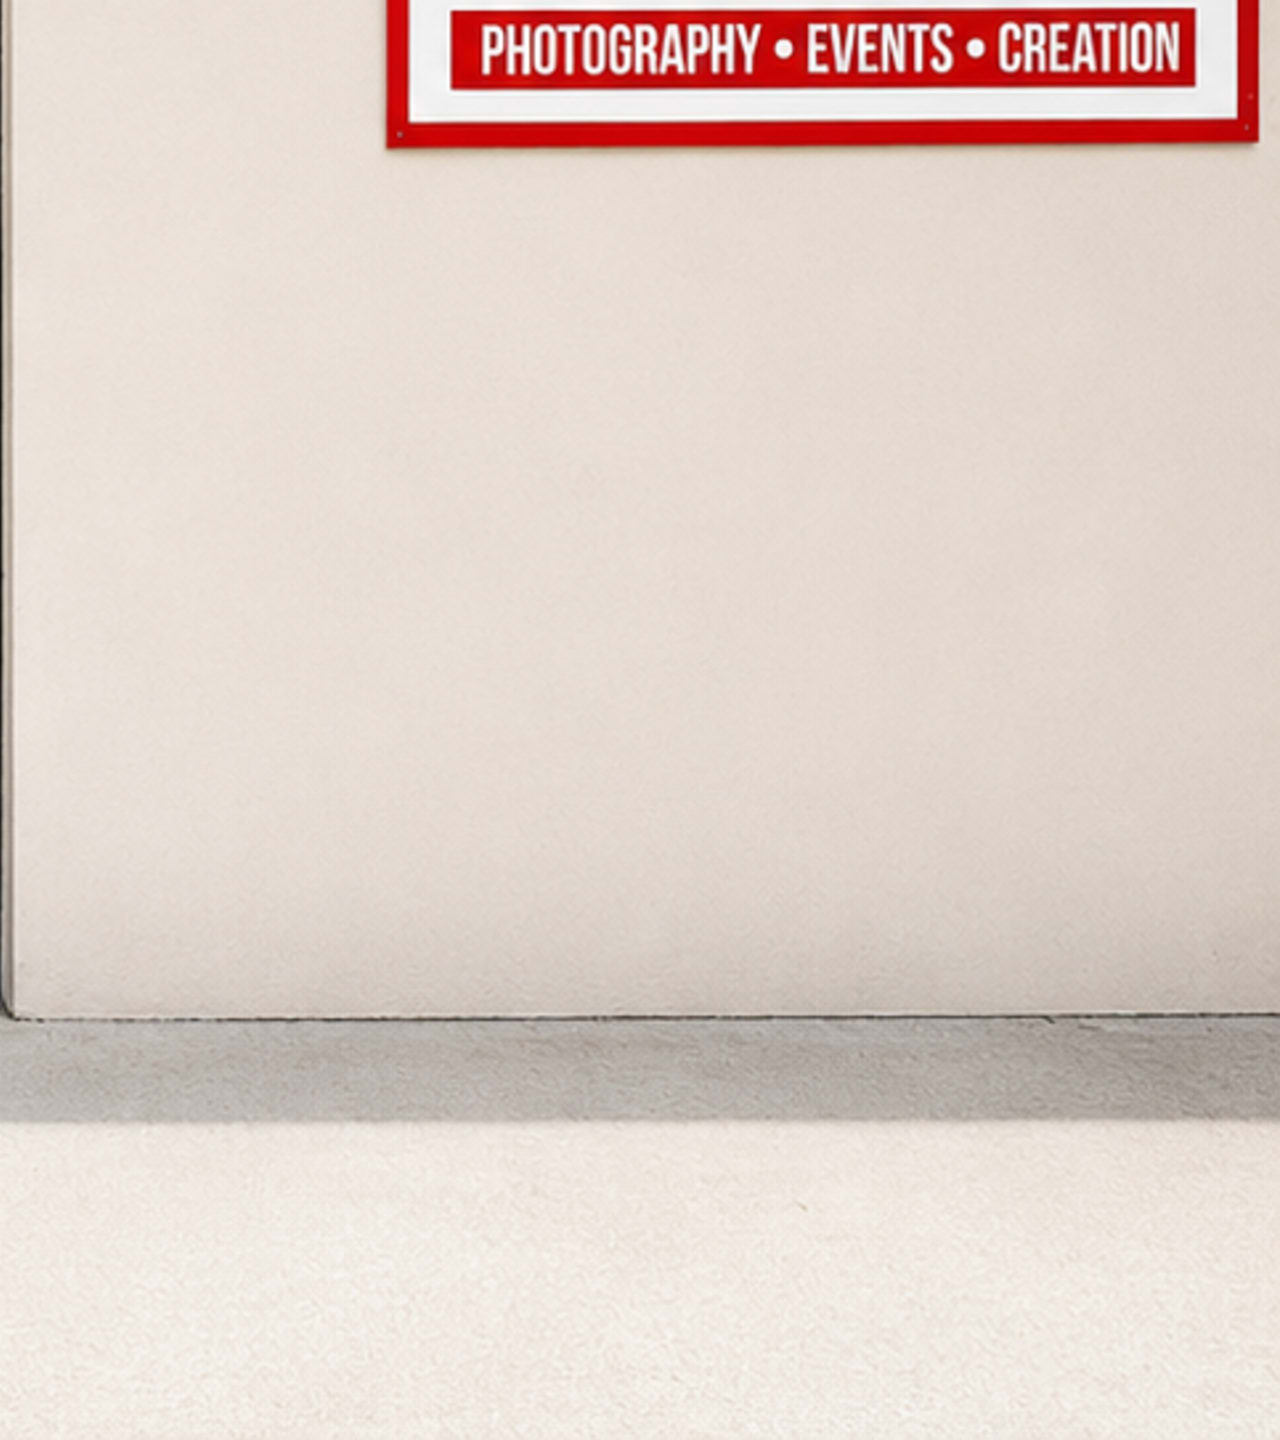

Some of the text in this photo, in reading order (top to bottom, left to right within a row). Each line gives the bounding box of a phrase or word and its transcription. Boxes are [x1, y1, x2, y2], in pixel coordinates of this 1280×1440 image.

[482, 21, 1180, 76] PHOTOGRAPHY EVENTS CREATION
